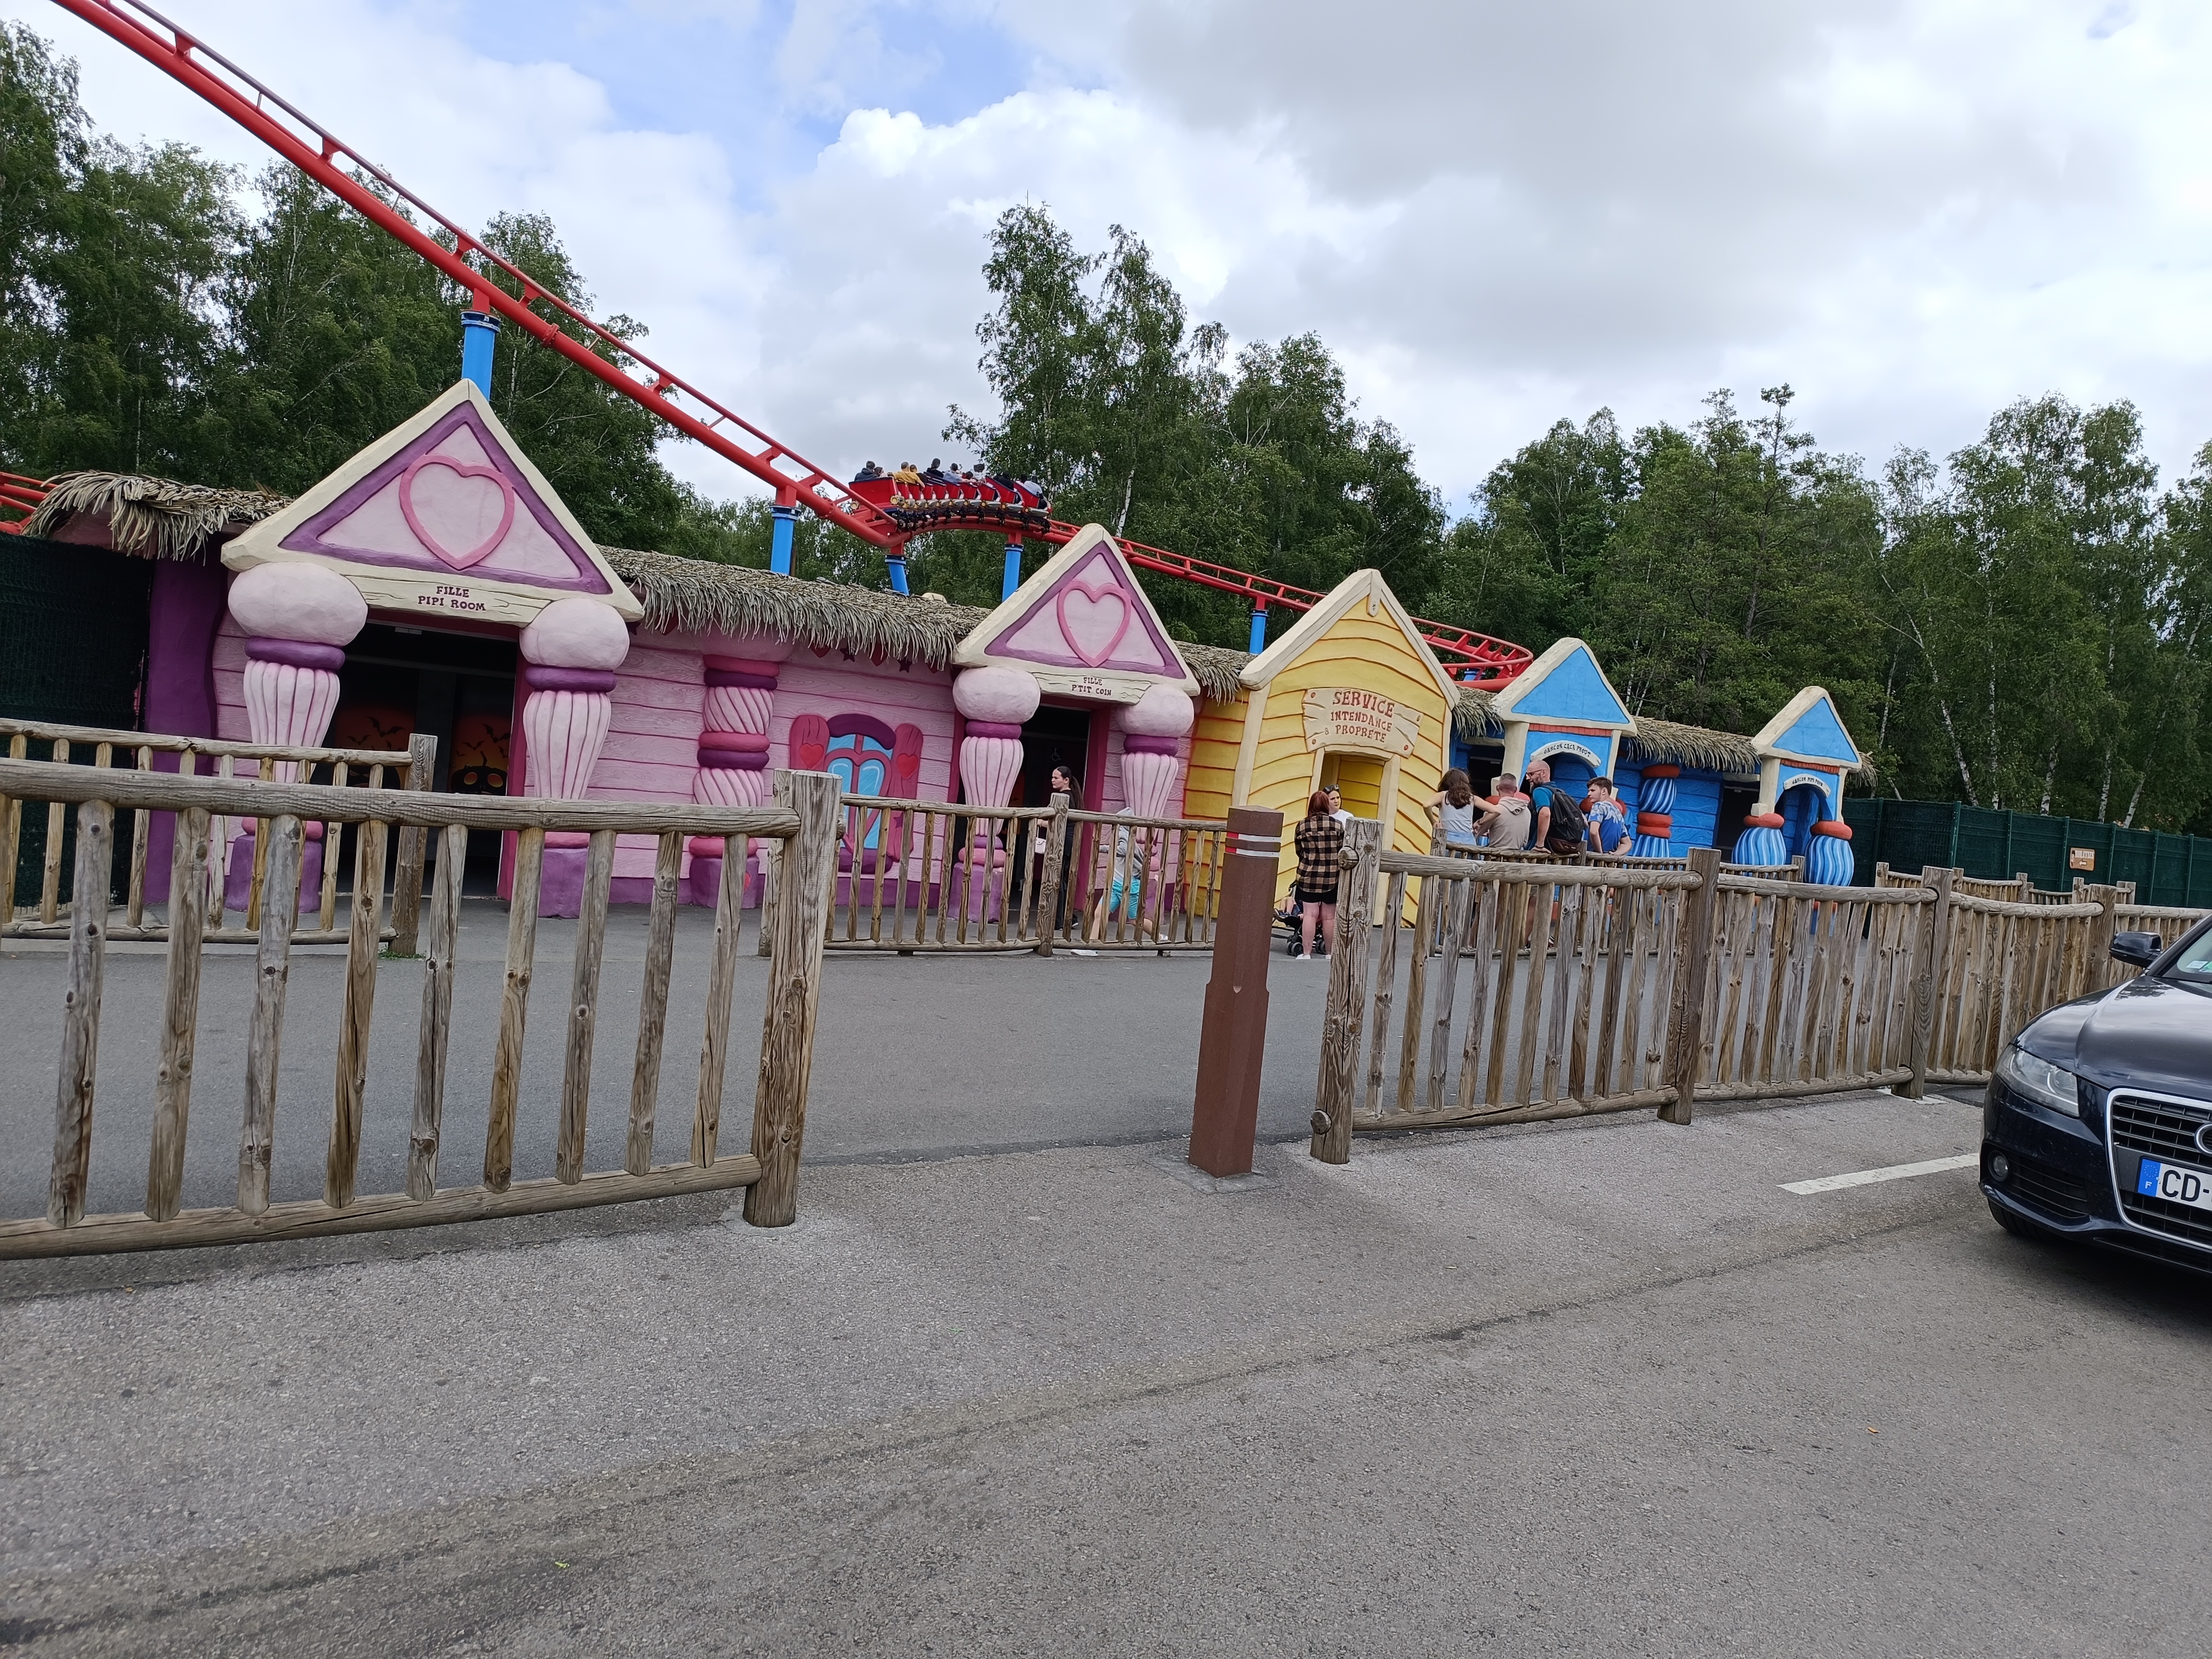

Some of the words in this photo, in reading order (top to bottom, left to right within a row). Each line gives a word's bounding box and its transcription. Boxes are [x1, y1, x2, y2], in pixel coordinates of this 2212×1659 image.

[436, 586, 469, 597] FILLE
[418, 596, 444, 606] PIPI
[451, 600, 486, 611] ROOM
[1083, 677, 1102, 685] FILLE
[1072, 684, 1092, 693] P'TIT
[1333, 689, 1394, 718] SERVICE
[1330, 711, 1392, 732] INTENDANCE
[1335, 725, 1386, 743] PROPRETE
[1577, 745, 1591, 757] PROUT
[2145, 1181, 2152, 1189] F
